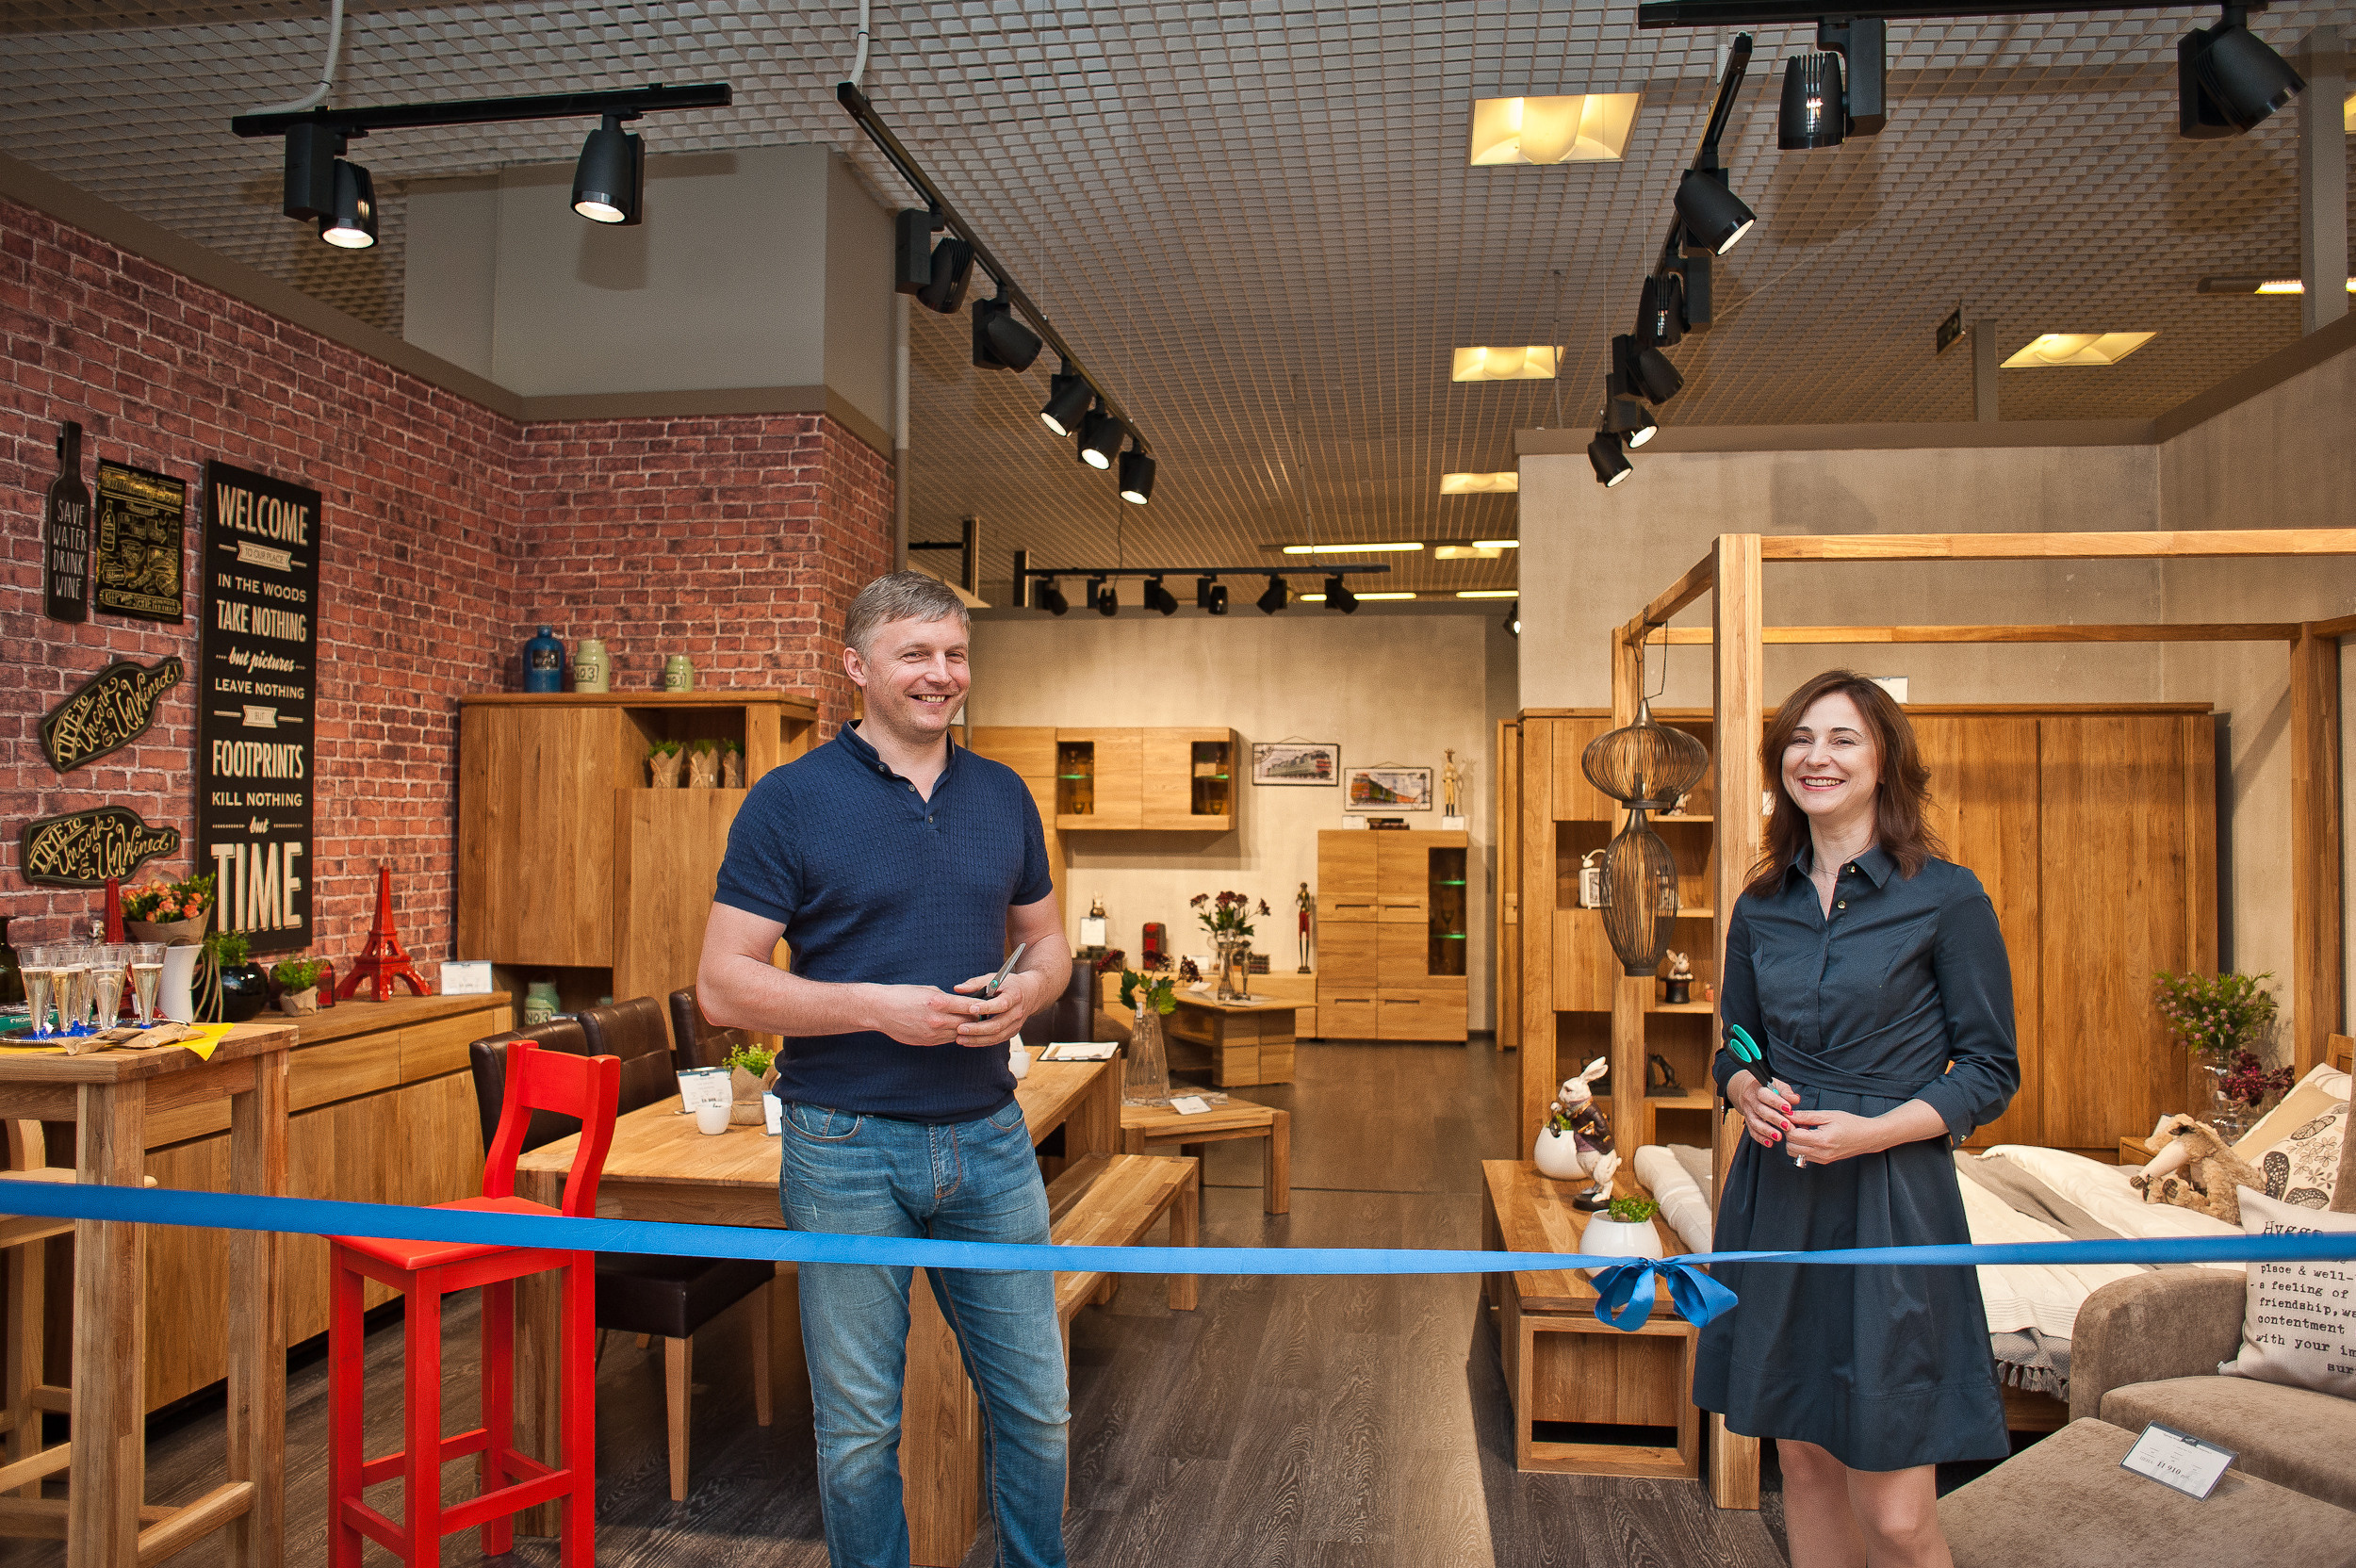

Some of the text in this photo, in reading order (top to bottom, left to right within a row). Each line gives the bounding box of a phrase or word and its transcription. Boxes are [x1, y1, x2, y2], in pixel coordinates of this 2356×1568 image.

[57, 498, 85, 526] SAVE
[217, 482, 309, 547] WELCOME
[53, 524, 87, 551] WATER
[53, 548, 84, 576] DRINK
[56, 575, 81, 600] WINE
[218, 573, 307, 603] IN THE WOODS
[217, 598, 307, 643] TAKE NOTHING
[228, 645, 295, 674] but pictures
[215, 678, 305, 700] LEAVE NOTHING
[57, 695, 89, 762] TIME TO
[75, 677, 119, 752] Uncork
[100, 721, 119, 747] &
[212, 740, 304, 779] FOOTPRINTS
[212, 792, 303, 808] KILL NOTHING
[249, 815, 270, 834] but
[29, 817, 81, 873] TIME TO
[53, 815, 116, 875] Uncork
[78, 852, 96, 880] &
[210, 841, 303, 935] TIME
[2261, 1264, 2292, 1274] place
[2299, 1266, 2306, 1275] &
[2271, 1281, 2323, 1297] feeling
[2331, 1289, 2348, 1298] of
[2258, 1315, 2346, 1334] contentment
[2256, 1334, 2285, 1346] with
[2295, 1338, 2331, 1351] your
